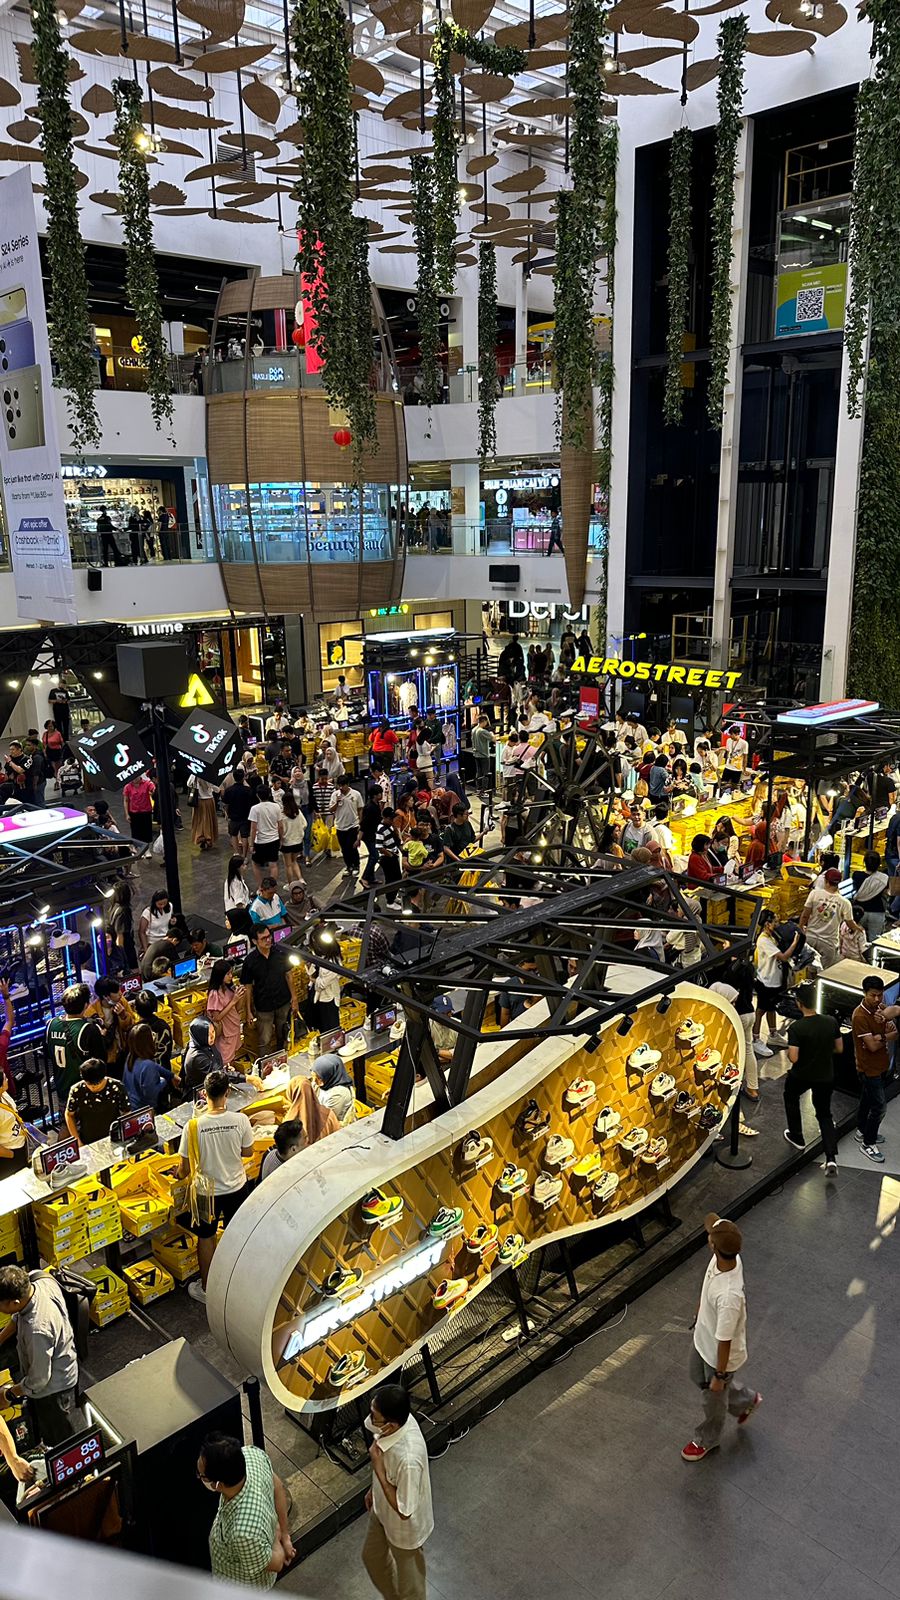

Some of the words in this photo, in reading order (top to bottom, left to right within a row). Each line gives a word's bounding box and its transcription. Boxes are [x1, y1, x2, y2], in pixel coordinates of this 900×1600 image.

[11, 234, 29, 251] Series
[570, 656, 742, 689] AEROSTREET
[204, 728, 228, 753] TikTok
[116, 760, 145, 782] TikTok
